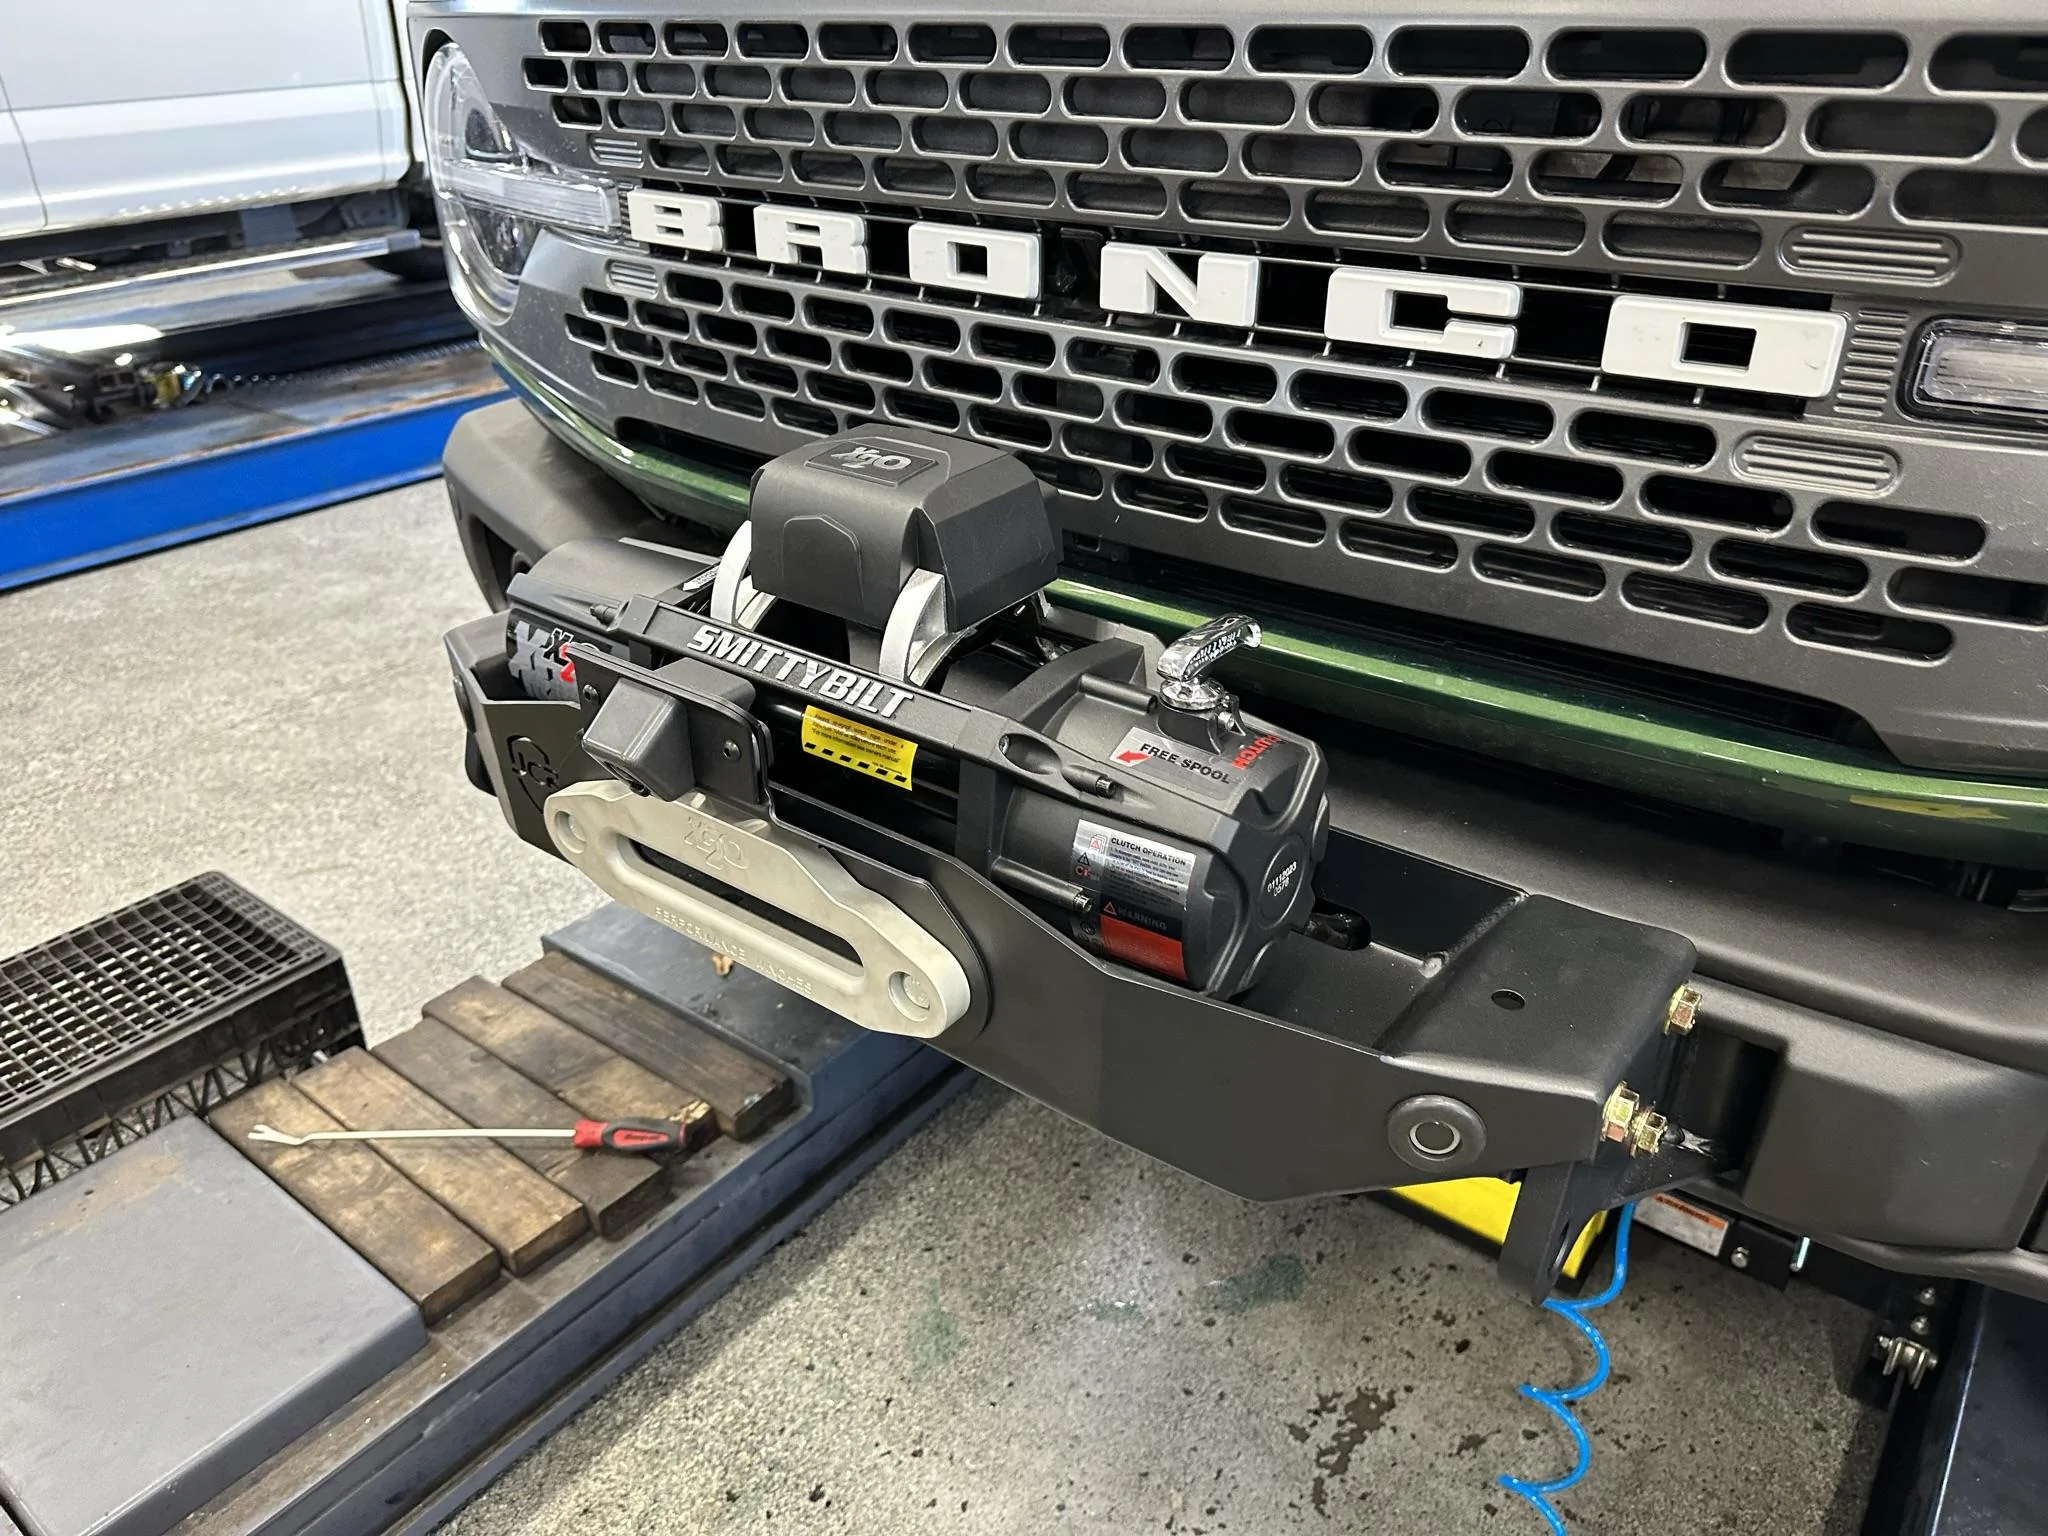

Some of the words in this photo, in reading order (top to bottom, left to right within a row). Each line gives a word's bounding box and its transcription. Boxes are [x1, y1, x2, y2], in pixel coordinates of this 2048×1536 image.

[627, 187, 1849, 398] BRONCO
[687, 624, 914, 718] SMITTYBILT
[1139, 743, 1179, 763] FREE
[1180, 758, 1231, 785] SPOOL
[1110, 836, 1141, 855] CLUTCH
[1142, 846, 1187, 867] OPERATION
[655, 906, 746, 962] PERFORMANCE
[1117, 906, 1169, 931] WARNING
